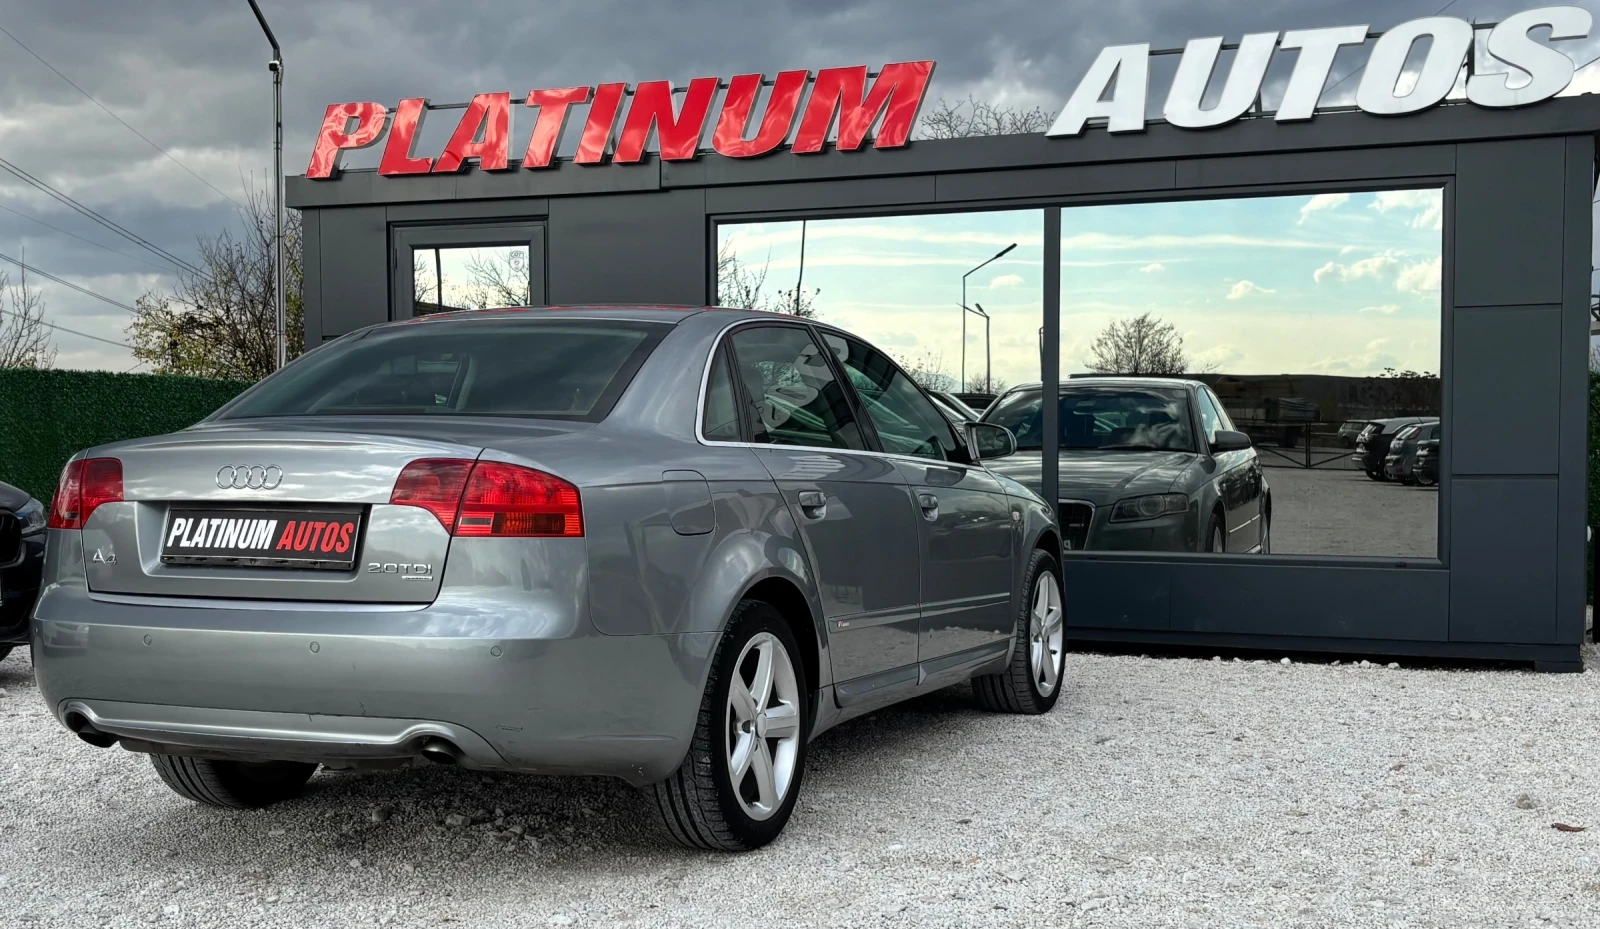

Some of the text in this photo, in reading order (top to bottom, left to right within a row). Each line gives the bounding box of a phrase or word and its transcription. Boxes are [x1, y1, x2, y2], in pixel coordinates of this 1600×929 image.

[306, 5, 1594, 179] PLATINUM AUTOS
[167, 518, 354, 553] PLATINUM AUTOS
[92, 548, 117, 565] A4
